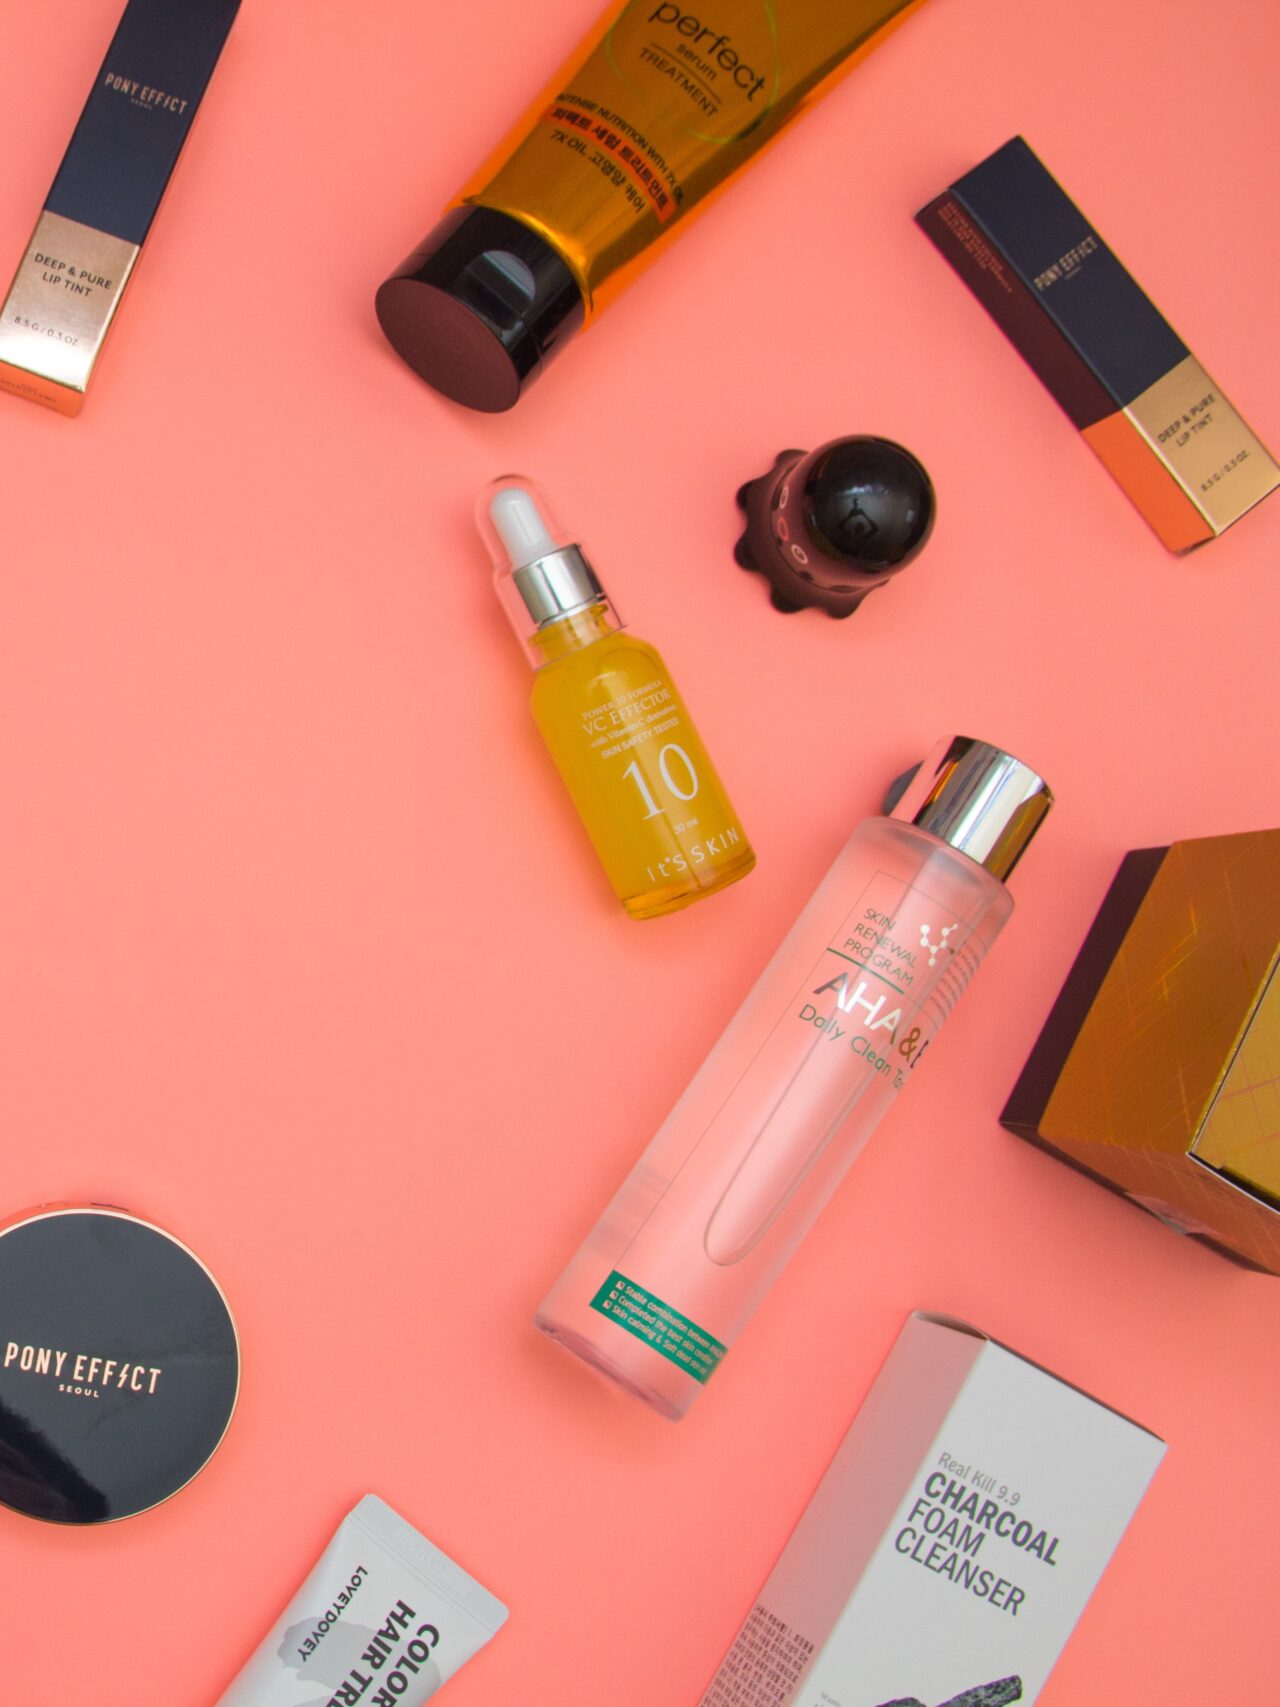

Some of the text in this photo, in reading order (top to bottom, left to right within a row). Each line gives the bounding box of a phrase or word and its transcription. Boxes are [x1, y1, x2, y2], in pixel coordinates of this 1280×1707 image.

[648, 2, 765, 102] perfect
[676, 43, 717, 81] serum
[104, 72, 139, 97] PONY
[640, 48, 719, 118] TREATMENT
[598, 103, 648, 149] NUTRITION
[647, 147, 668, 174] WITH
[550, 129, 645, 214] 7X OIL 고영양 케어
[593, 125, 622, 151] 세럼
[619, 145, 669, 210] 트리트먼트
[34, 253, 112, 289] DEEP & PURE
[42, 272, 93, 296] LIP TINT
[1033, 264, 1063, 292] PONY
[1157, 392, 1216, 444] DEEP & PURE
[1176, 413, 1213, 447] LIP TINT
[582, 688, 672, 736] VC EFFECTOR
[622, 730, 653, 751] SAFETY
[622, 743, 699, 820] 10
[672, 816, 700, 835] 30 ml
[690, 827, 740, 863] SKIN
[863, 908, 897, 931] SKIN
[843, 937, 914, 987] PROGRAM
[853, 923, 919, 969] RENEWAL
[798, 1004, 846, 1042] Daily
[850, 1036, 891, 1077] Clean
[813, 972, 903, 1045] AHA
[898, 1027, 921, 1062] &
[612, 1304, 628, 1320] Skin
[627, 1316, 656, 1341] calming
[663, 1340, 677, 1353] Soft
[618, 1296, 655, 1324] Completed
[655, 1320, 668, 1332] the
[4, 1341, 68, 1377] PONY
[58, 1384, 100, 1398] SEOUL
[938, 1452, 1021, 1506] Real Kill 9.9
[907, 1497, 986, 1558] FOAM
[924, 1471, 1059, 1566] CHARCOAL
[894, 1527, 1026, 1616] CLEANSER
[297, 1565, 368, 1662] LOVEYDOVEY
[361, 1600, 416, 1670] HAIR
[371, 1623, 440, 1707] COLOR
